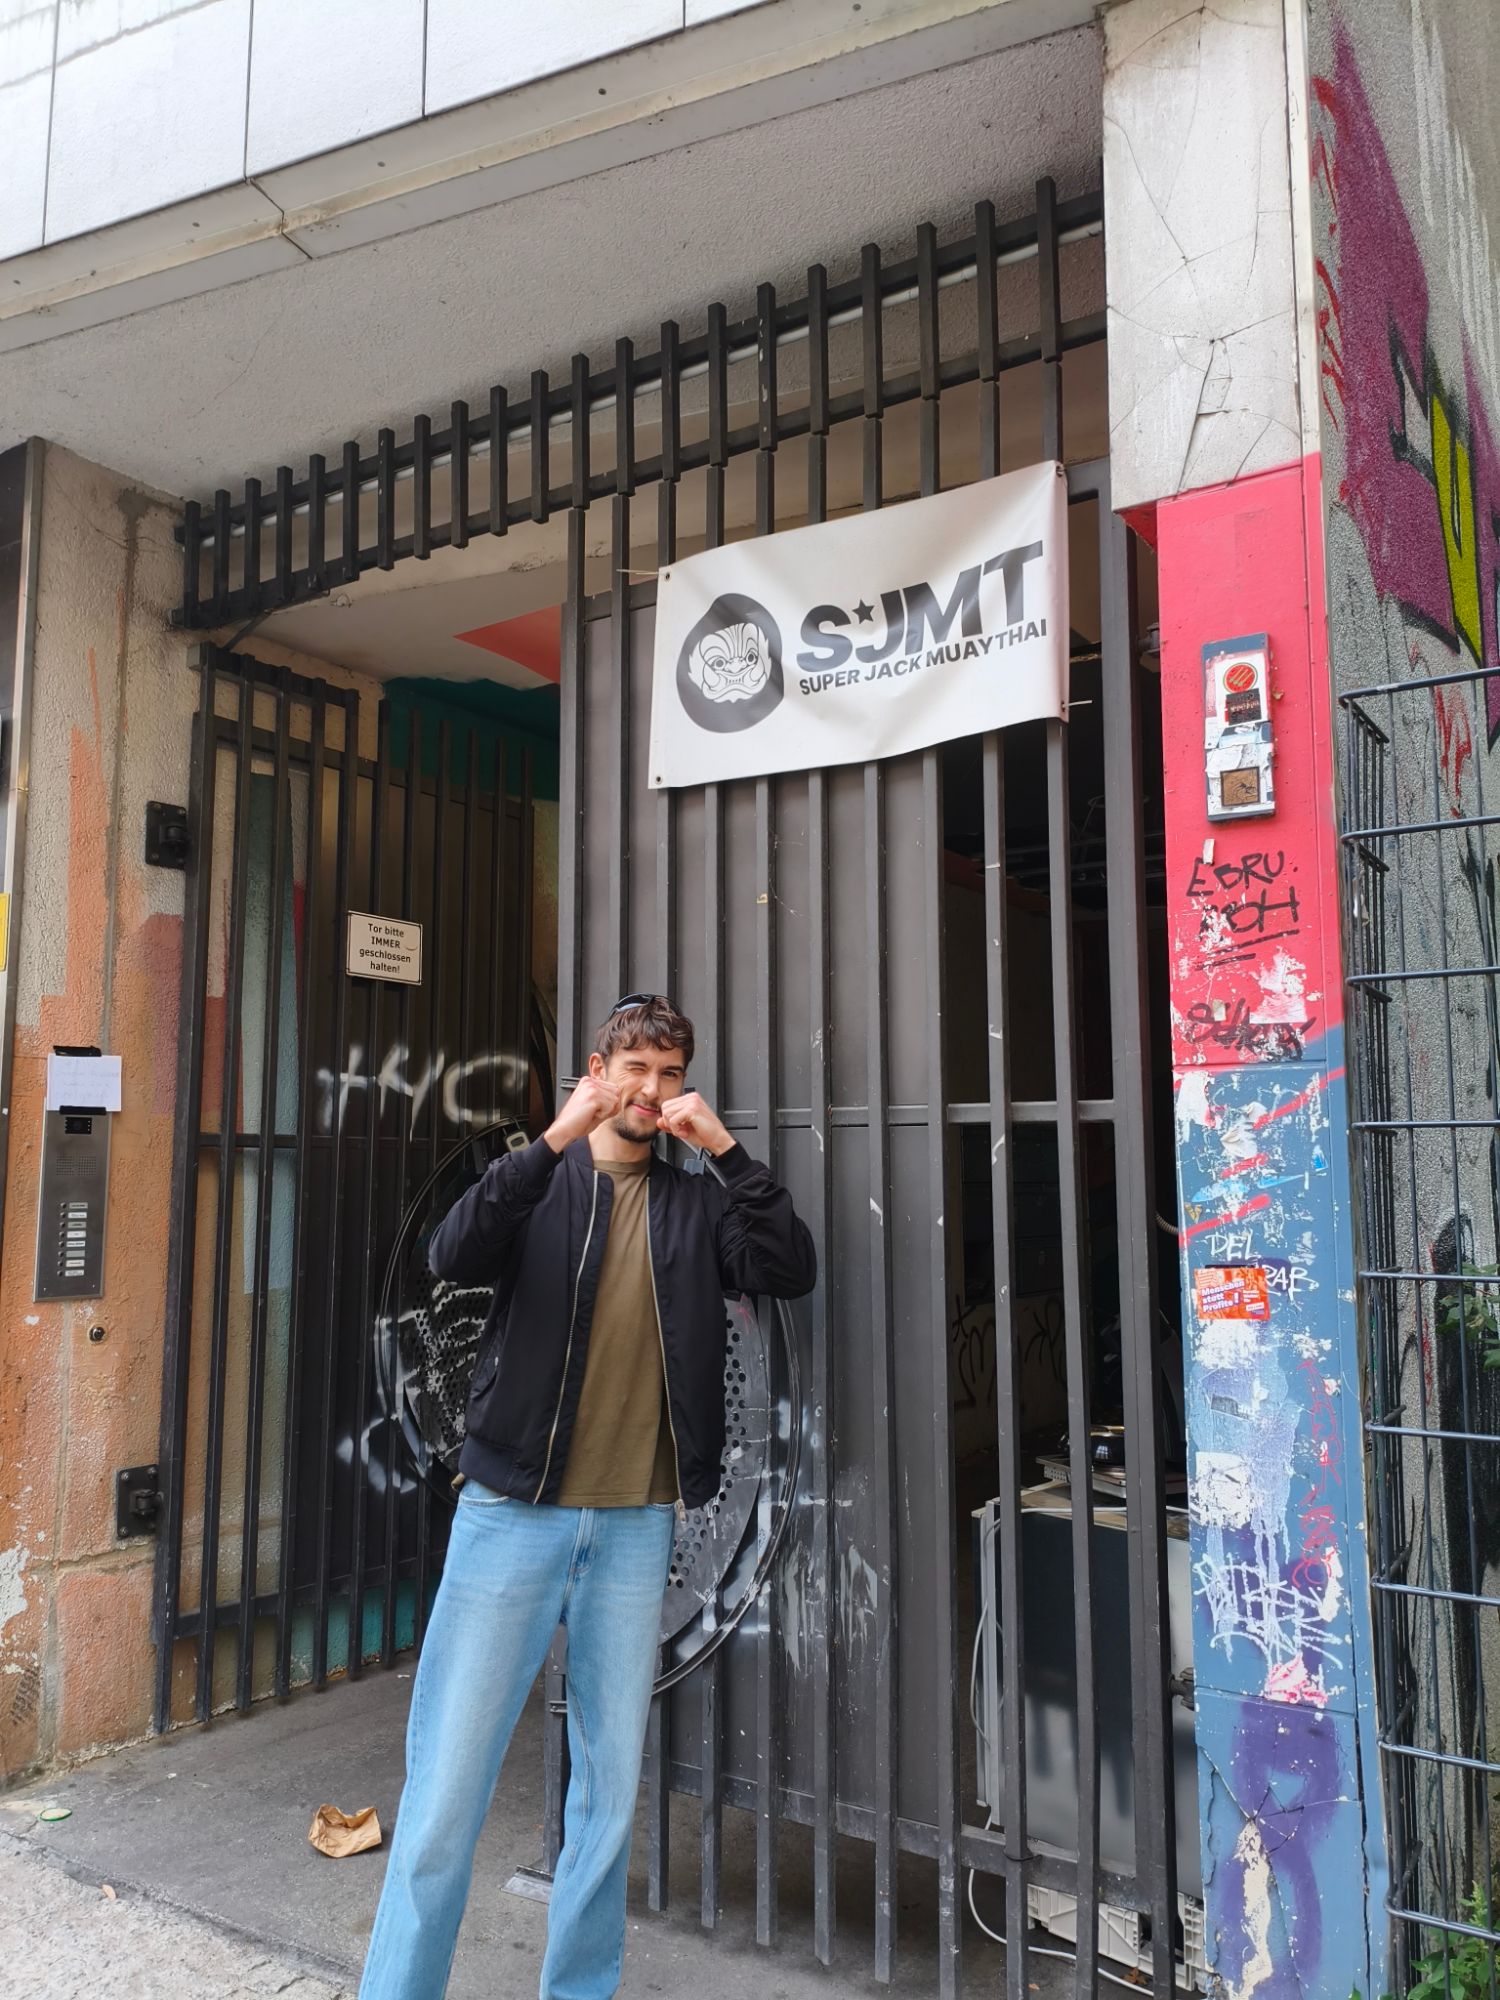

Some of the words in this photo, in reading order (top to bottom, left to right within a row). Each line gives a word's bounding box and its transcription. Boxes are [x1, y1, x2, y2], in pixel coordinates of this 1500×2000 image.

[797, 540, 1043, 672] SJMT
[800, 669, 860, 695] SUPER
[864, 655, 923, 682] JACK
[368, 923, 382, 934] Tor
[385, 926, 404, 938] bitte
[371, 936, 401, 949] IMMER
[359, 948, 411, 963] geschlossen
[370, 961, 400, 973] halten!
[1201, 1280, 1245, 1296] Menschen
[1203, 1293, 1225, 1303] statt
[1203, 1300, 1233, 1312] Profite
